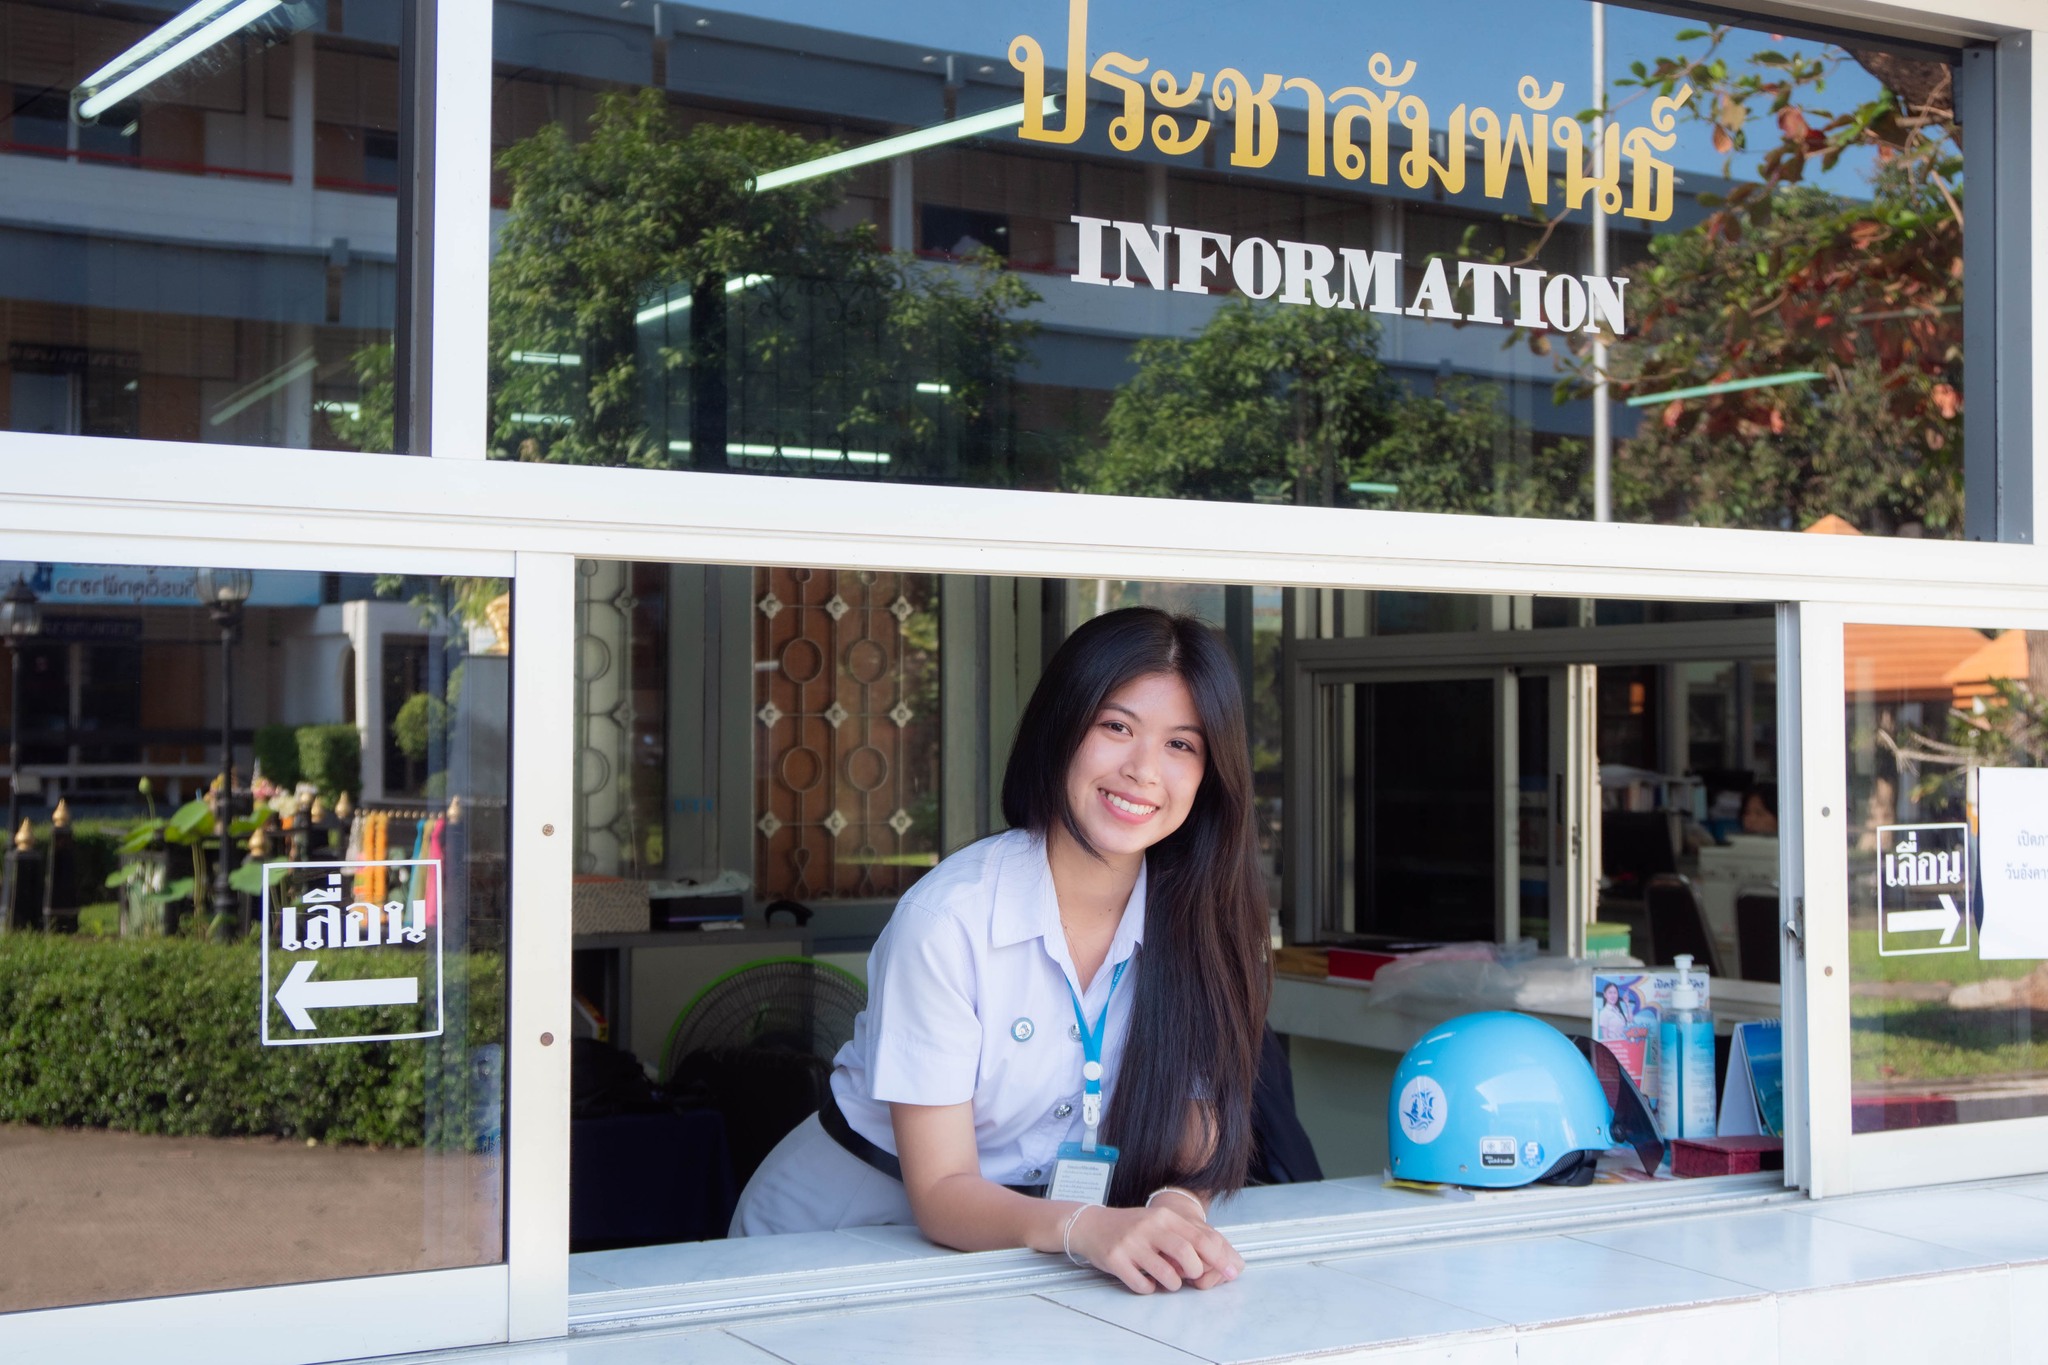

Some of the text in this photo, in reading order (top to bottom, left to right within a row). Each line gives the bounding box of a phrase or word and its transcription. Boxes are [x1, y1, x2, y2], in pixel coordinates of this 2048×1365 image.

[1008, 0, 1692, 222] ประชาสัมพันธ์
[1071, 215, 1629, 335] INFORMATION
[1885, 831, 1961, 887] เลื่อน
[282, 873, 427, 951] เลื่อน
